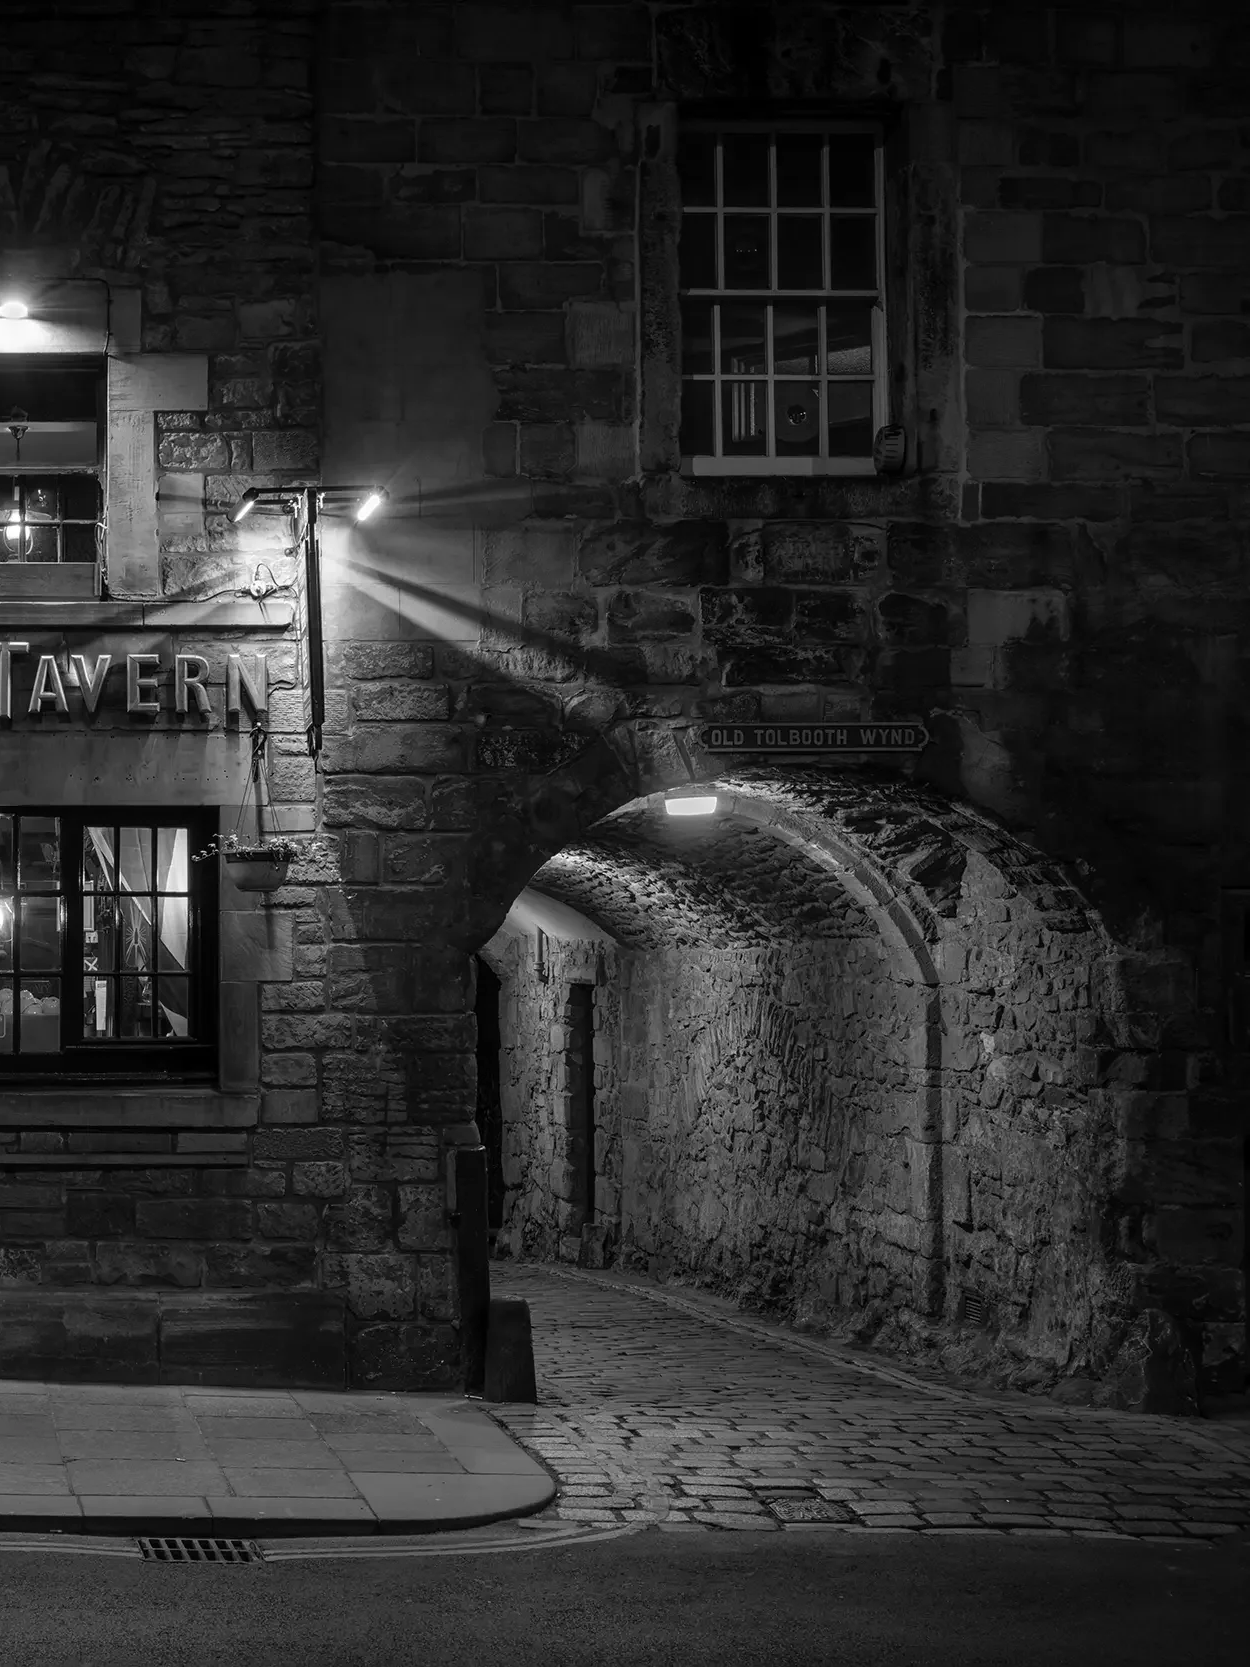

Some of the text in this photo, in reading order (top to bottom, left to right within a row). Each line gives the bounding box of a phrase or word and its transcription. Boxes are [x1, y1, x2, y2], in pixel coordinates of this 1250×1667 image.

[711, 728, 915, 746] OLD TOLBOOTH WYND
